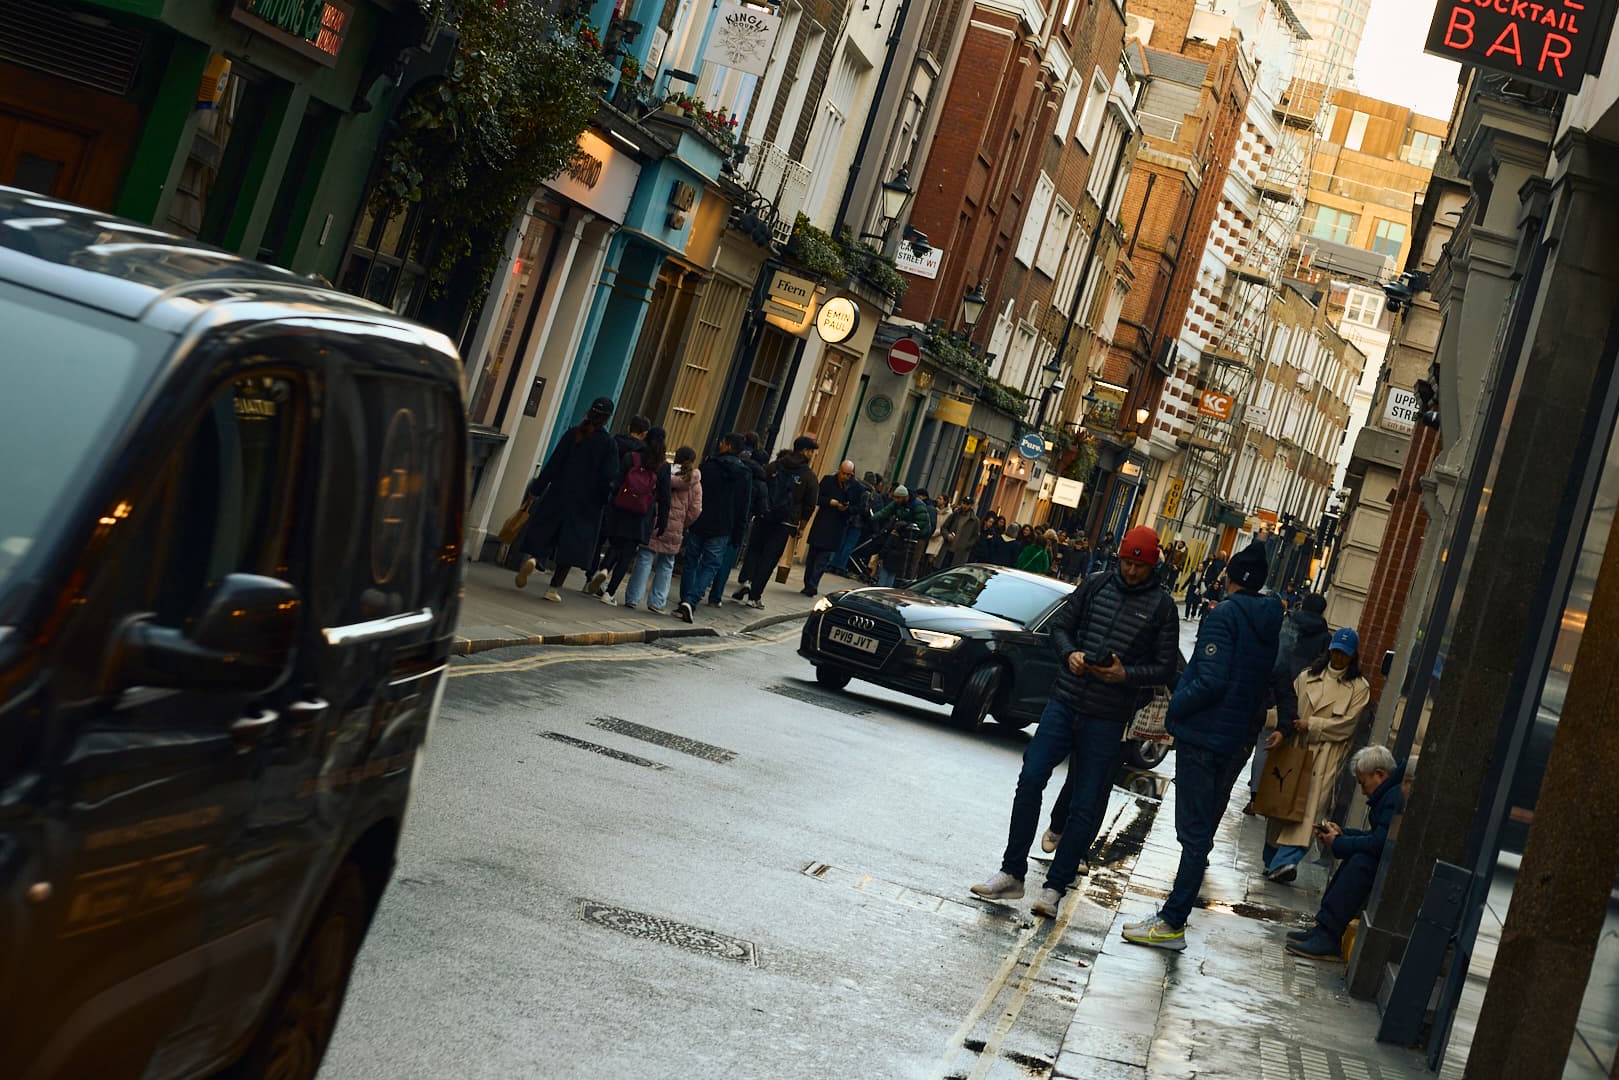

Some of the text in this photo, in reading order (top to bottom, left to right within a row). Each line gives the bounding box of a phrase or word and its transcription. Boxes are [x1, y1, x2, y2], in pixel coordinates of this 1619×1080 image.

[725, 13, 769, 33] KINGLY
[1443, 6, 1572, 77] BAR
[898, 251, 937, 268] STREET W1
[777, 280, 806, 297] Ffern
[826, 309, 849, 323] EMIN
[823, 319, 846, 332] PAUL
[834, 629, 873, 649] PV19 JVT
